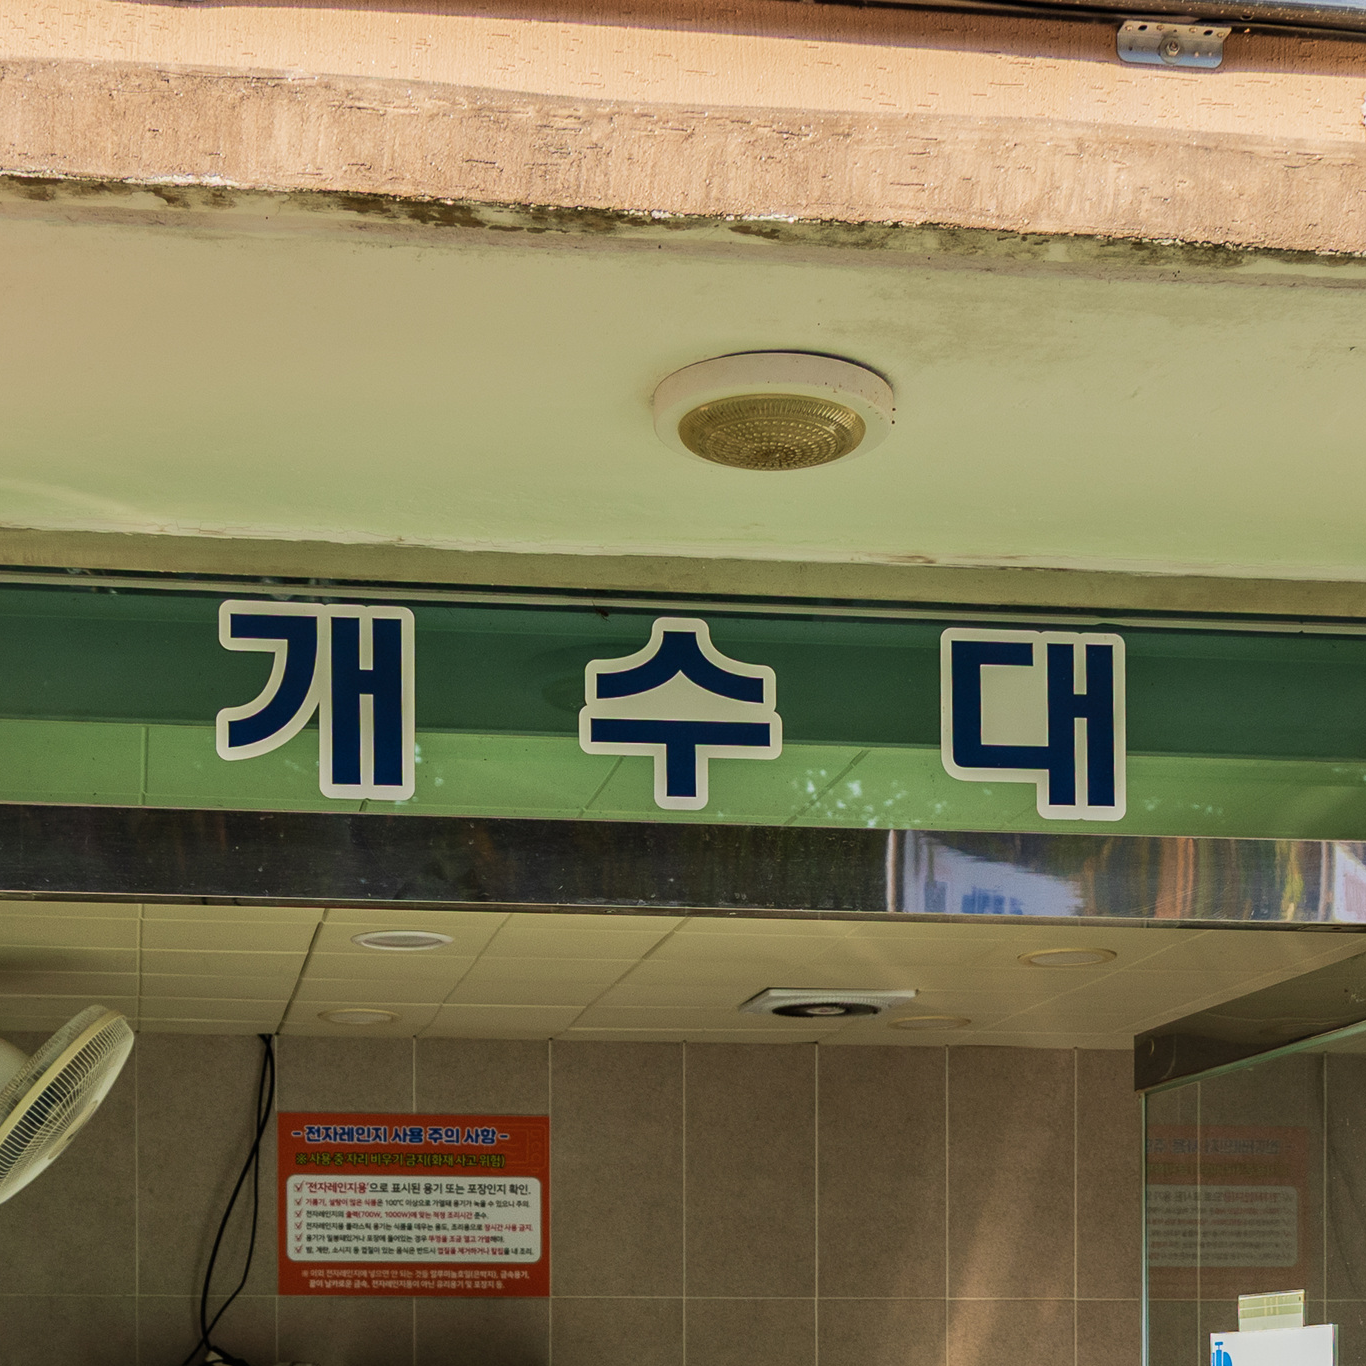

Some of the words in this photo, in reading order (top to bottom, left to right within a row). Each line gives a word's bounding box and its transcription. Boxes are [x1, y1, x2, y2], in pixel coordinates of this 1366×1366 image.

[306, 1125, 388, 1144] 전자레인지
[391, 1126, 423, 1144] 사용
[428, 1127, 459, 1145] 주의
[463, 1127, 496, 1145] 사항
[346, 1153, 368, 1166] 자리
[370, 1154, 402, 1167] 비우기
[455, 1154, 477, 1167] 사고
[391, 1183, 421, 1195] 표시된
[423, 1183, 443, 1195] 용기
[445, 1183, 466, 1195] 또는
[467, 1183, 506, 1195] 포장인지
[509, 1183, 531, 1195] 확인.
